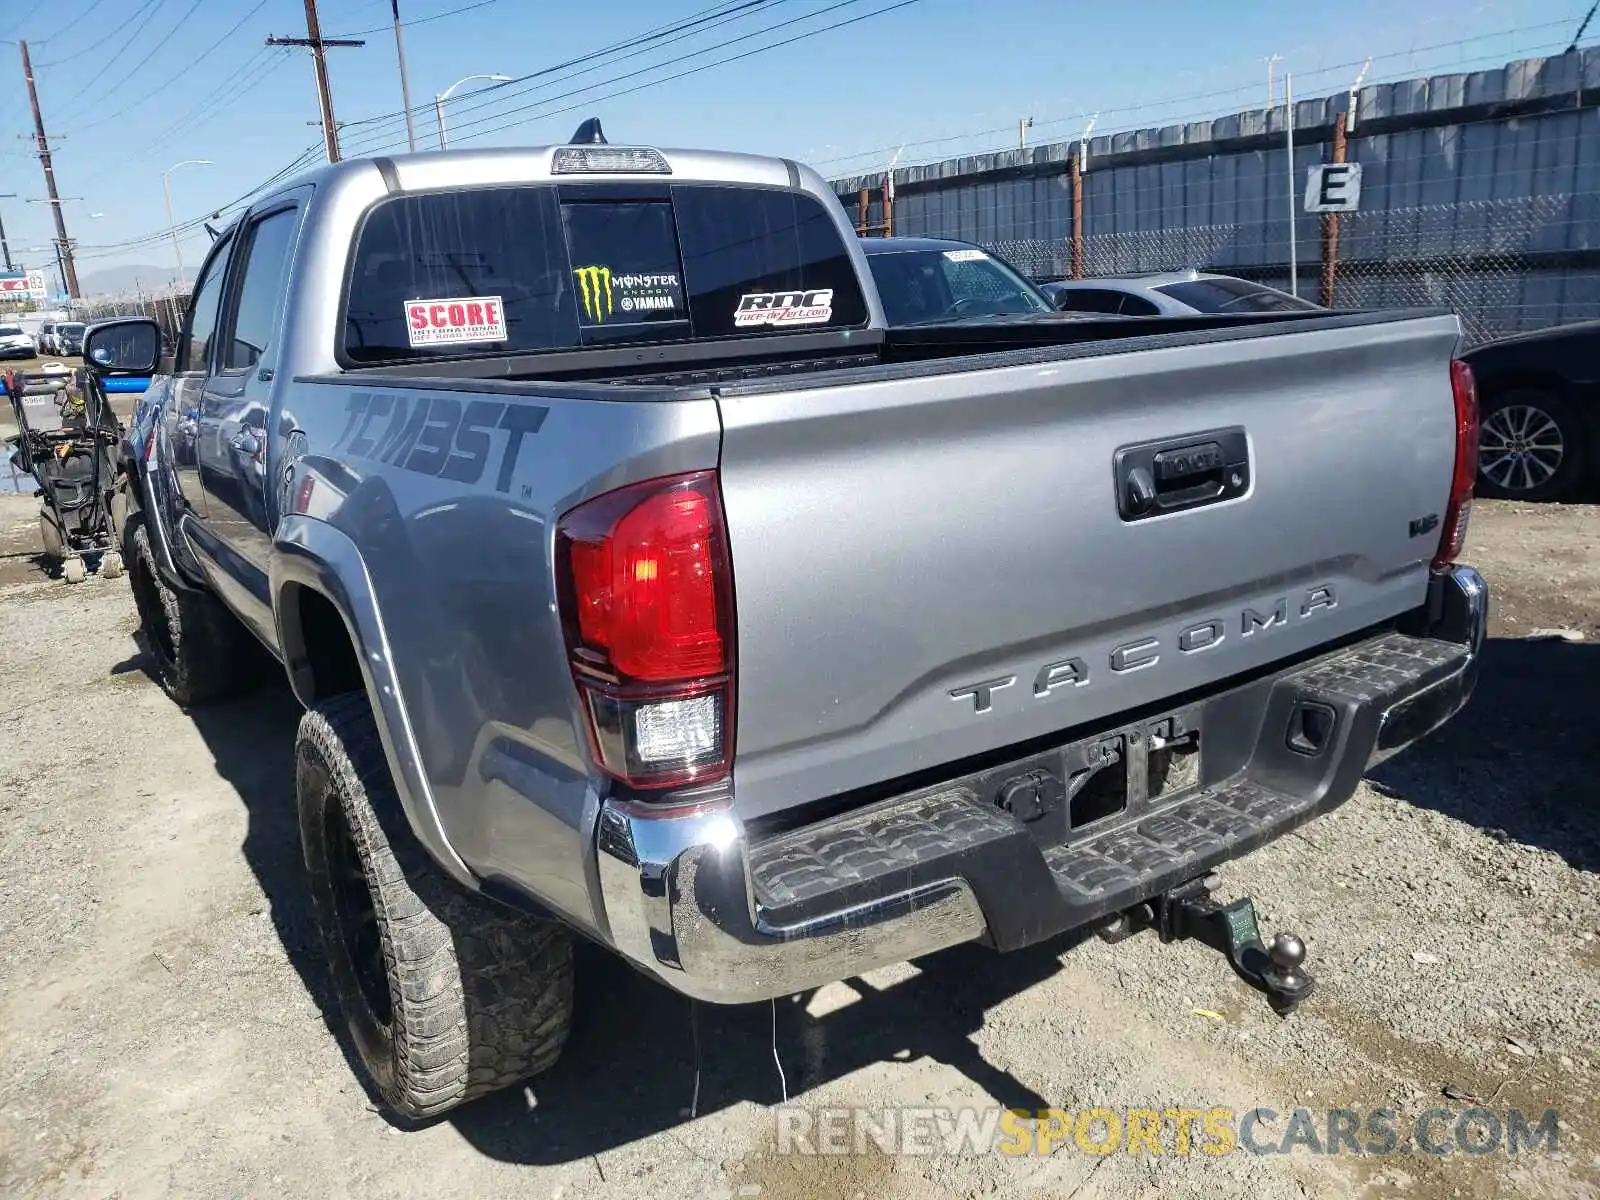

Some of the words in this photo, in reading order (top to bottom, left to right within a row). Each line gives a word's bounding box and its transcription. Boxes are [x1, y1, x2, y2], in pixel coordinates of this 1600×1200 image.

[1319, 166, 1349, 205] E
[611, 275, 679, 289] MONSTER
[623, 288, 670, 296] ENERGY
[632, 296, 675, 310] YAMAHA
[740, 291, 831, 312] RDC
[409, 302, 500, 330] SCORE
[1157, 445, 1221, 479] TOYOTA
[947, 583, 1340, 714] TACOMA
